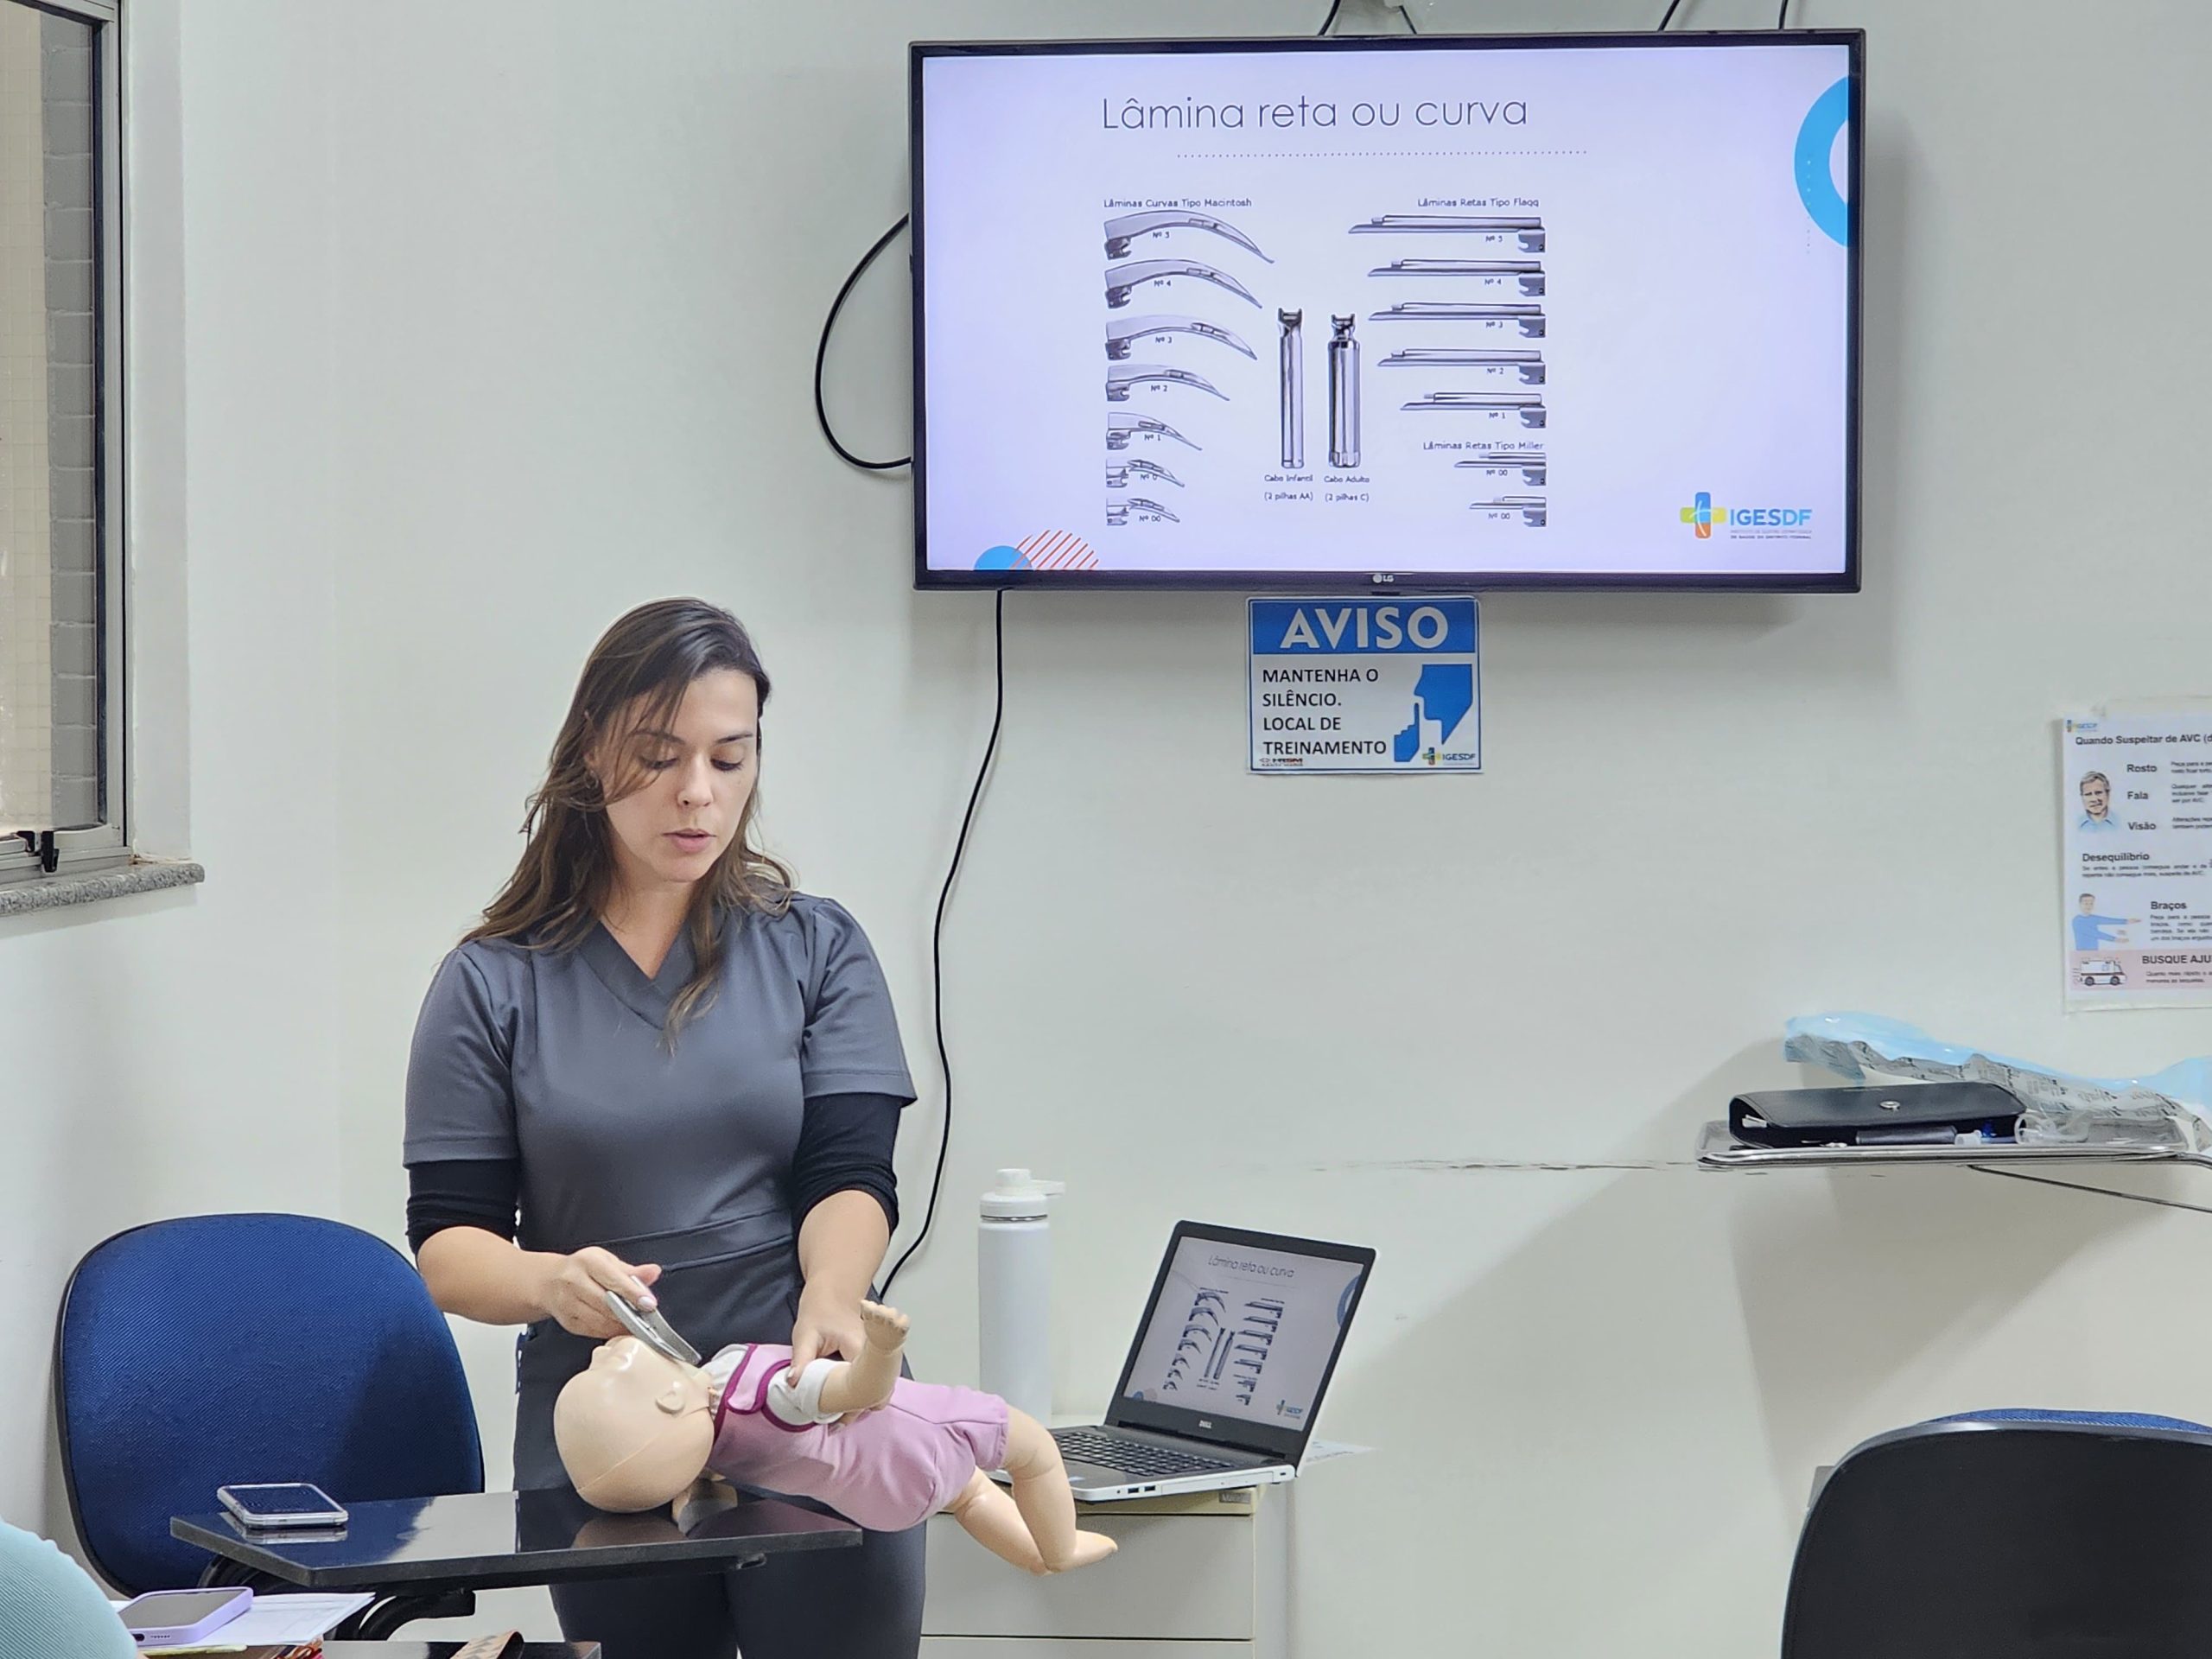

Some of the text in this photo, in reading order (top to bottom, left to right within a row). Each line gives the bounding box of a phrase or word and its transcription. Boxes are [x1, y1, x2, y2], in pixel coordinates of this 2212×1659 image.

[1102, 95, 1529, 130] Lâmina reta ou curva
[1103, 200, 1142, 208] Lâminas
[1182, 198, 1201, 208] Tipo
[1205, 198, 1252, 207] Macintosh
[1418, 198, 1457, 207] Lâminas
[1460, 198, 1486, 207] Retas
[1491, 198, 1510, 207] Tipo
[1496, 442, 1515, 450] Tipo
[1300, 492, 1313, 501] AA)
[1360, 493, 1369, 502] C)
[1730, 509, 1813, 525] IGESDF
[1280, 606, 1448, 649] AVISO
[1262, 668, 1379, 683] MANTENHA O
[1262, 690, 1342, 707] SILÊNCIO.
[1263, 716, 1342, 730] LOCAL DE
[2116, 735, 2162, 746] Suspeitar
[2165, 734, 2177, 743] de
[1262, 741, 1387, 755] TREINAMENTO
[2126, 764, 2158, 772] Rosto
[2127, 822, 2157, 830] Visão
[2150, 901, 2187, 911] Braços
[2142, 955, 2188, 964] BUSQUE
